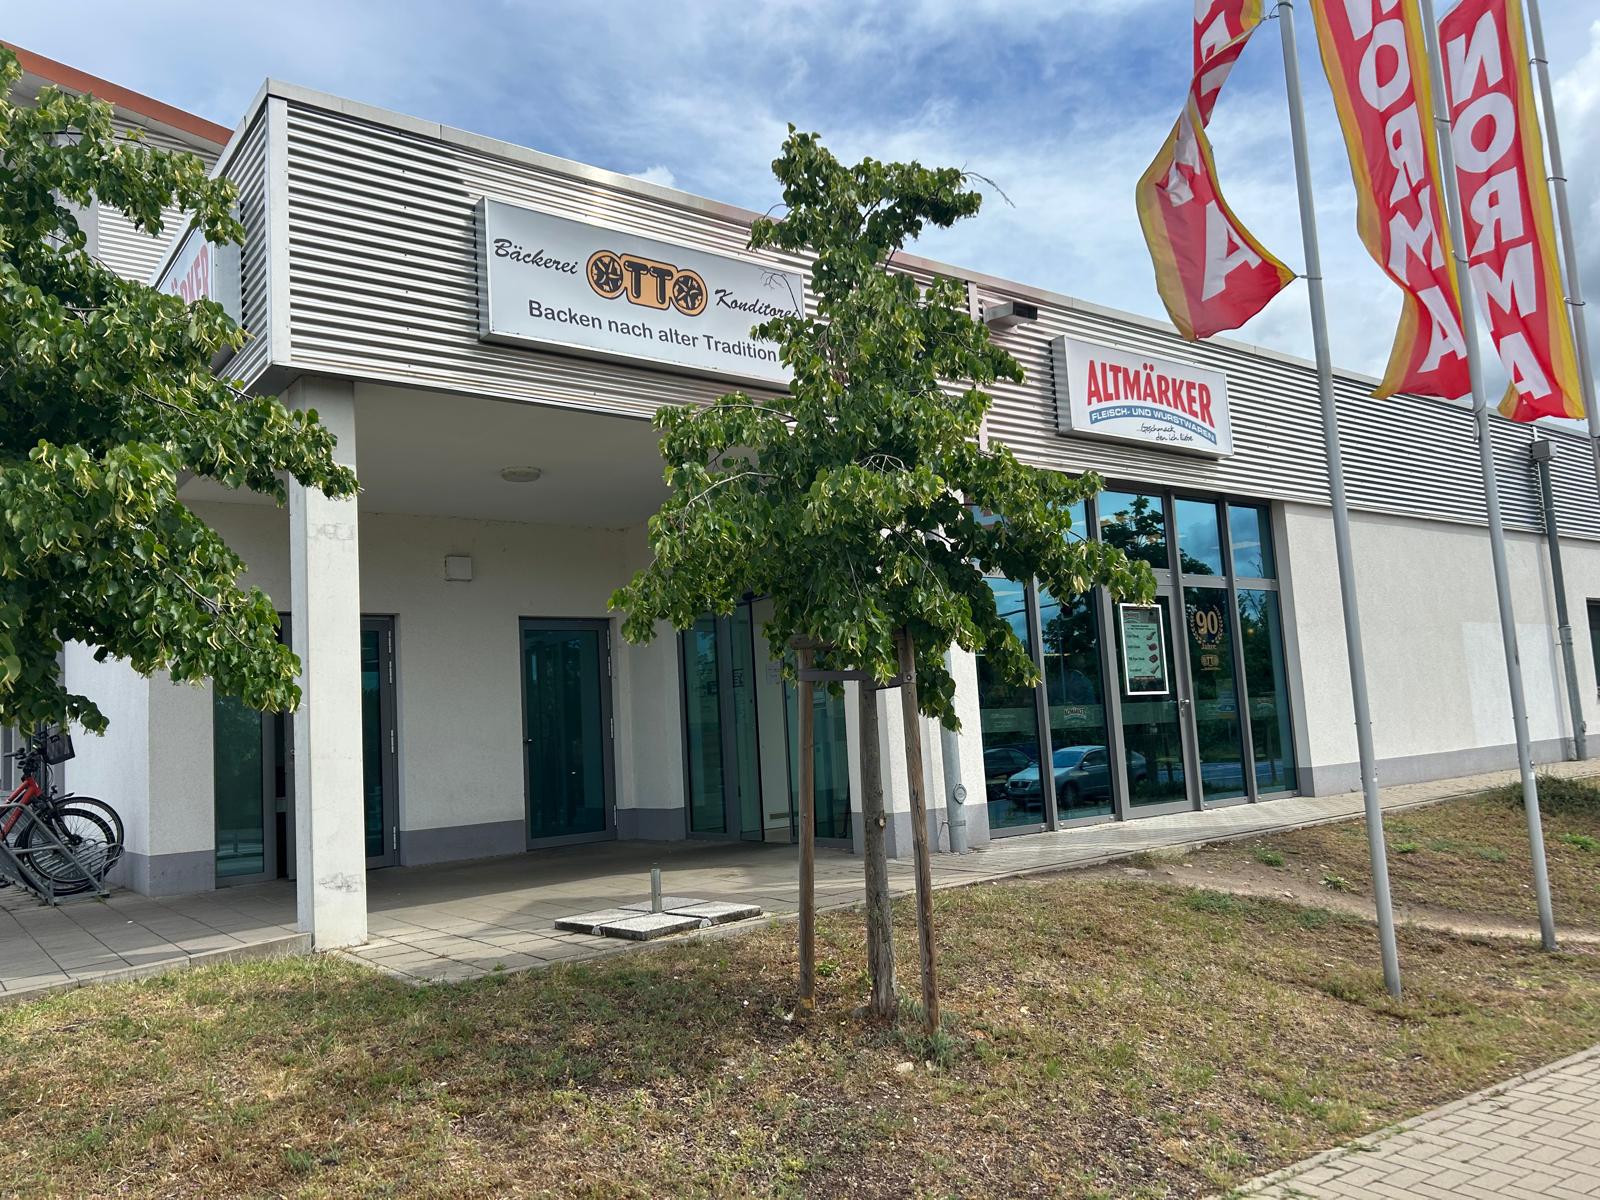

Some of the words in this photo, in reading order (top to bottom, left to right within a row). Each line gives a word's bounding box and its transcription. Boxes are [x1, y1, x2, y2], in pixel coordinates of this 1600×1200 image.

[493, 238, 579, 275] Bäckerei
[528, 299, 603, 330] Backen
[608, 318, 654, 340] nach
[658, 327, 698, 349] alter
[702, 334, 777, 363] Tradition
[1087, 360, 1215, 428] ALTMÄRKER
[1092, 408, 1131, 422] FLEISCH-
[1133, 407, 1152, 417] UND
[1154, 411, 1216, 443] WURSTWAREN
[1195, 610, 1219, 635] 90
